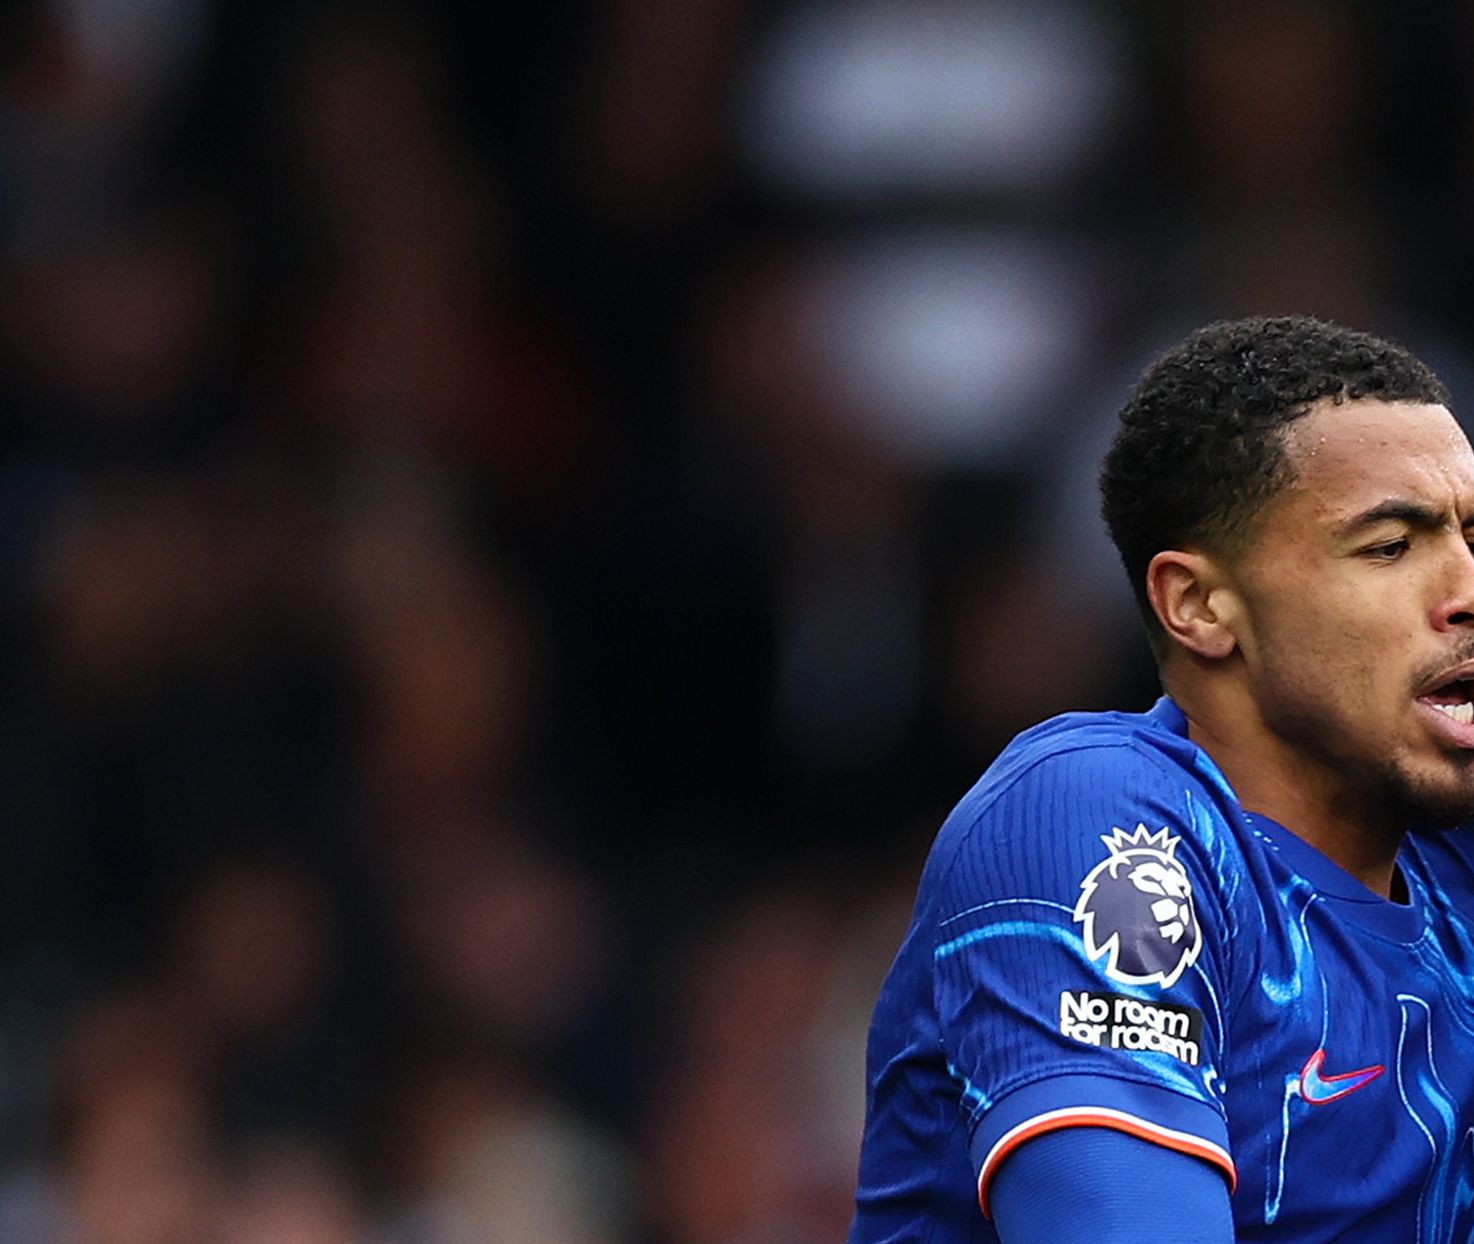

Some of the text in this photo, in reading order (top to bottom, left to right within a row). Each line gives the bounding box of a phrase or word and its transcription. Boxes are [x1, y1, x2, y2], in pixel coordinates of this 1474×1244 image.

[1060, 990, 1191, 1038] No room
[1060, 1015, 1108, 1047] for
